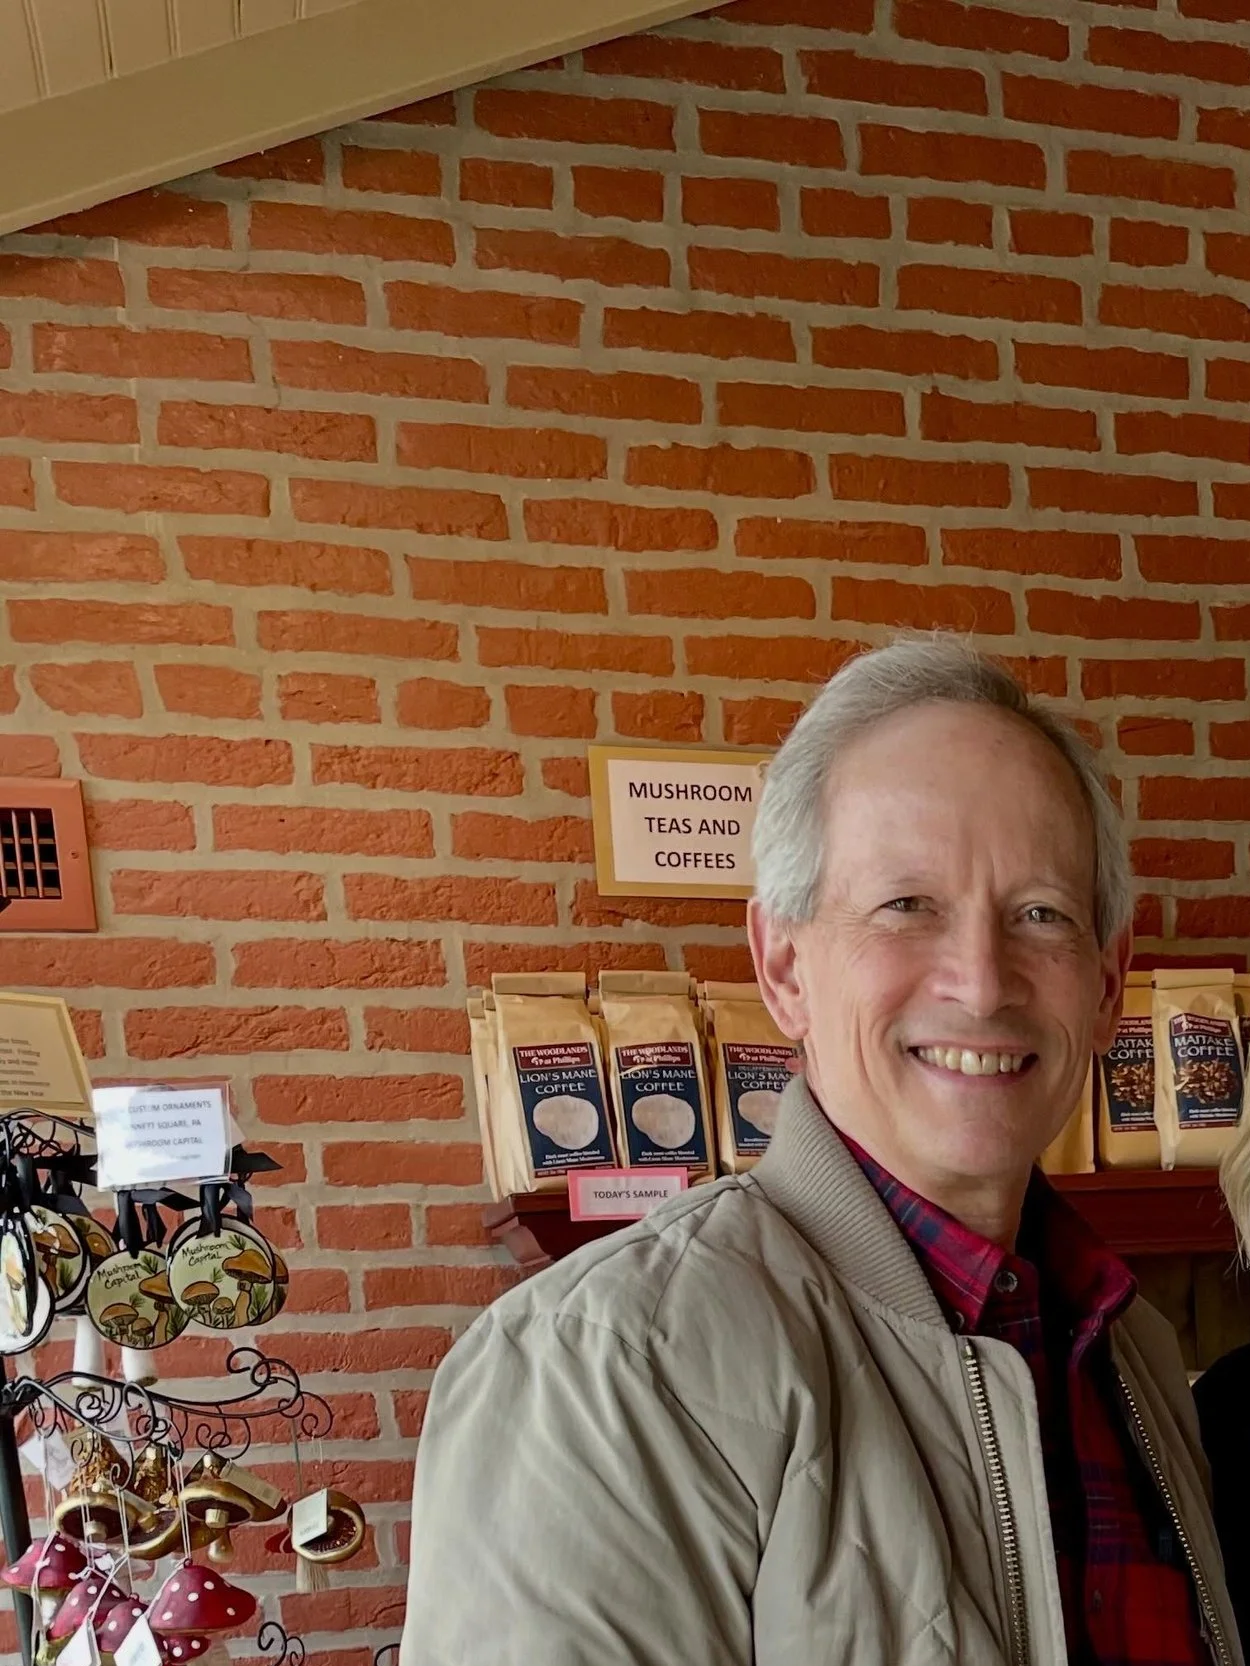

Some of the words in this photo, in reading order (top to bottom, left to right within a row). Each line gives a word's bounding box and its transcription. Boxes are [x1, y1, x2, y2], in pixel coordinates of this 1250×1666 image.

[629, 782, 752, 802] MUSHROOM
[645, 817, 692, 834] TEAS
[698, 819, 740, 835] AND
[655, 851, 736, 869] COFFEES
[1113, 1039, 1153, 1049] AITAK
[1174, 1035, 1235, 1047] MAITAKE
[519, 1050, 532, 1058] THE
[532, 1046, 588, 1057] WOODLANDS
[744, 1046, 793, 1056] WOODLANDS
[1108, 1049, 1154, 1060] COFFE
[1177, 1046, 1235, 1057] COFFEE
[552, 1055, 581, 1065] Phillips
[519, 1071, 560, 1084] LION'S
[562, 1069, 597, 1080] MANE
[662, 1069, 697, 1080] MANE
[727, 1071, 766, 1080] LION'S
[535, 1082, 586, 1095] COFFEE
[635, 1082, 685, 1092] COFFEE
[128, 1105, 160, 1113] CUSTM
[162, 1100, 212, 1110] ORNAMENTS
[191, 1119, 202, 1127] PA
[173, 1137, 203, 1146] CAPITAL
[593, 1190, 631, 1199] TODAY'S
[633, 1190, 668, 1198] SAMPLE
[182, 1242, 231, 1259] Mushroom
[189, 1252, 222, 1267] Capital
[97, 1262, 142, 1280] Mushroom
[104, 1270, 141, 1290] Capital
